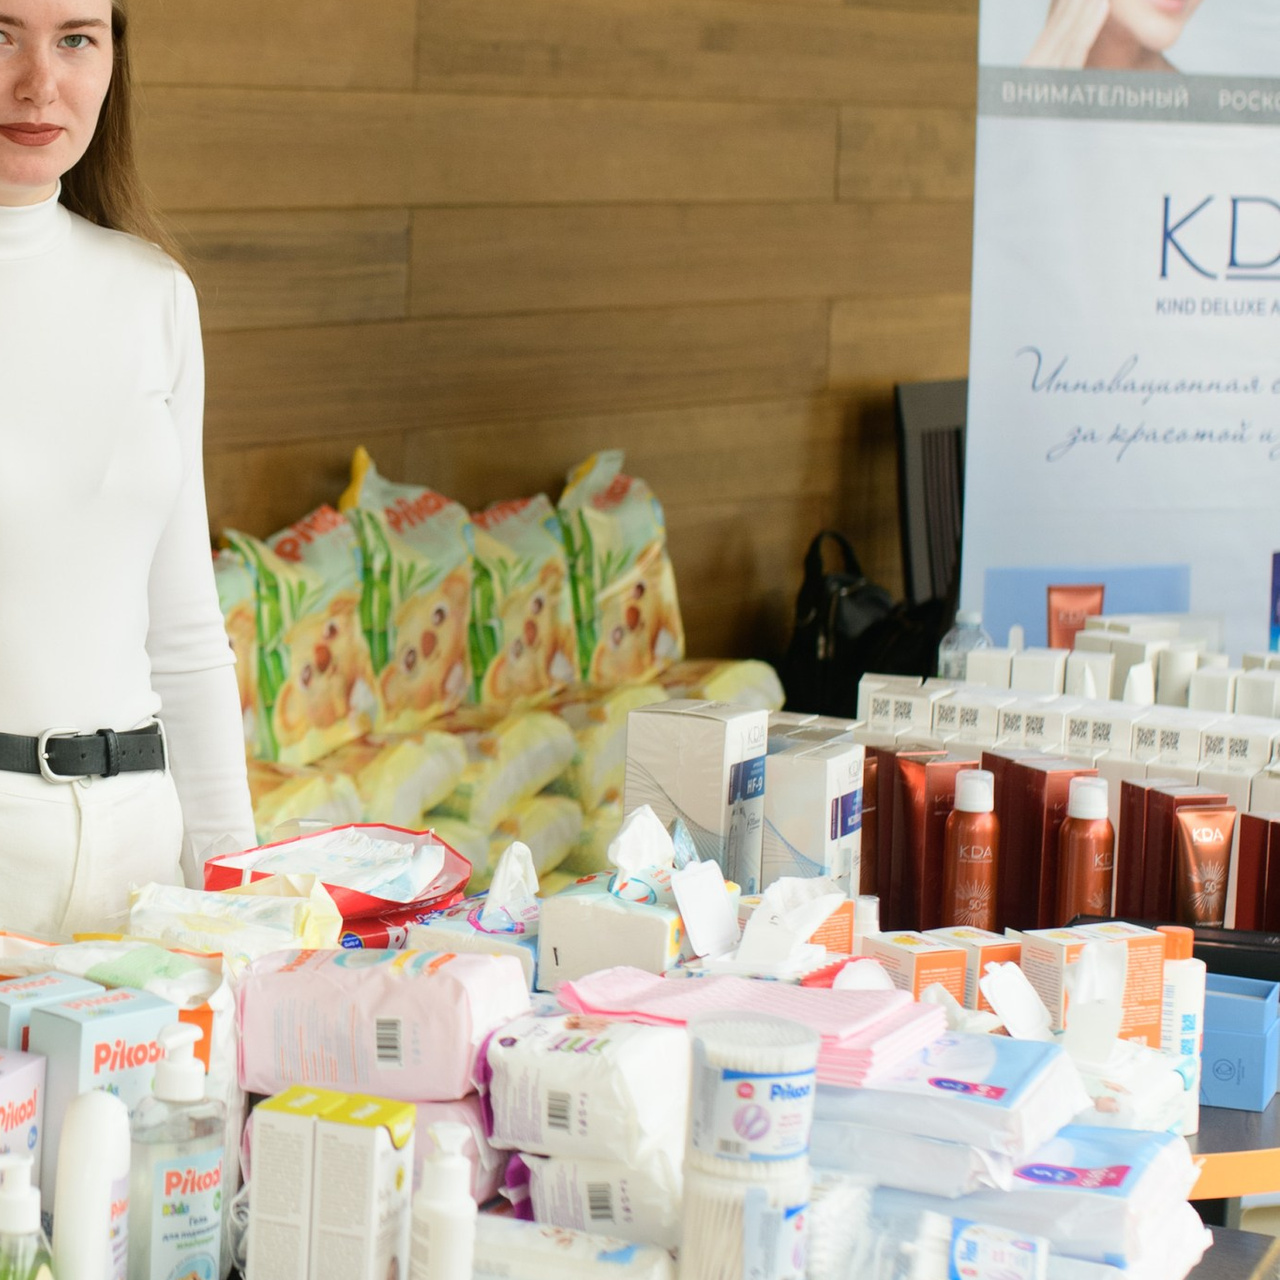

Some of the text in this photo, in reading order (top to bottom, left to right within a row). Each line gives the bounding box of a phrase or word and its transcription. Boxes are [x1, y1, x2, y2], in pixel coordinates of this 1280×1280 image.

[1002, 81, 1189, 108] ВНИМАТЕЛЬНЫЙ
[1156, 297, 1195, 316] KIND
[1201, 297, 1266, 317] DELUXE
[1016, 345, 1261, 406] Инновационная
[1046, 425, 1096, 463] за
[1107, 419, 1249, 463] красотой
[1192, 827, 1225, 842] KDA
[959, 845, 993, 859] KDA
